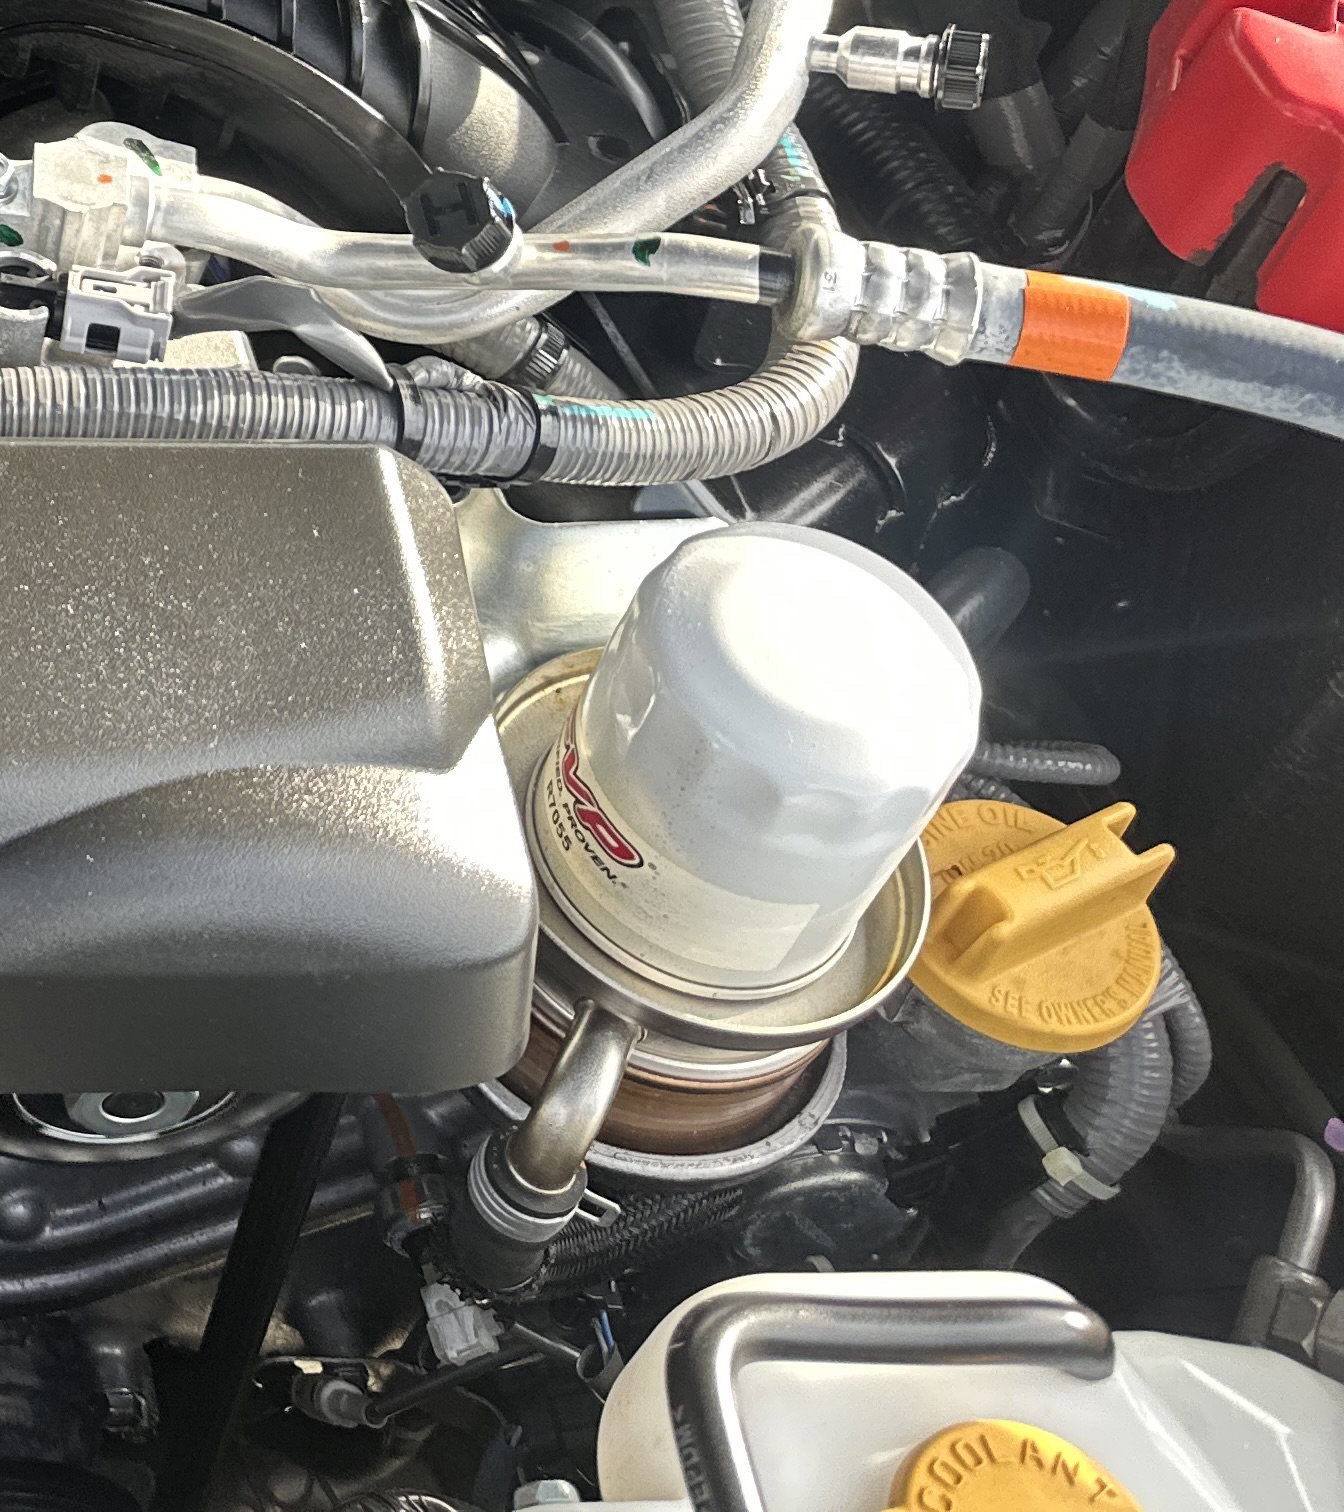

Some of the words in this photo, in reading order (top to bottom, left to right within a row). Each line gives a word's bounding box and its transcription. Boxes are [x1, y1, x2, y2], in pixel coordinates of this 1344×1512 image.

[977, 802, 1034, 834] OIL
[988, 984, 1030, 1019] SEE
[1038, 986, 1128, 1026] OWNER'S
[1115, 921, 1156, 1002] MANUAL
[917, 1434, 1118, 1512] COOLANT
